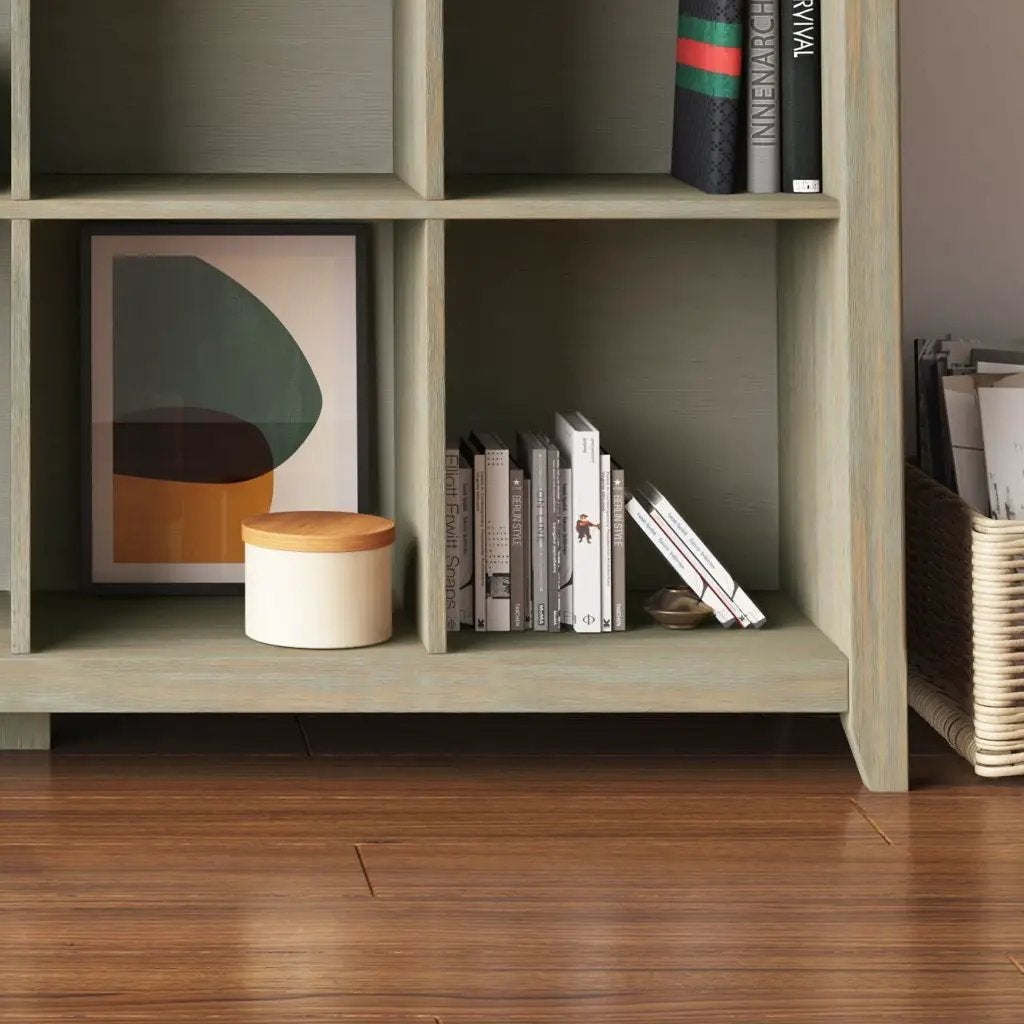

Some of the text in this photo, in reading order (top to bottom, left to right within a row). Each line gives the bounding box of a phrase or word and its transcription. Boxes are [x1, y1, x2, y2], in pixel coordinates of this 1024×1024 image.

[446, 454, 460, 609] Elliott Erwitt Snaps
[512, 494, 522, 547] BERLIN STYLE
[614, 494, 624, 547] BERLIN STYLE
